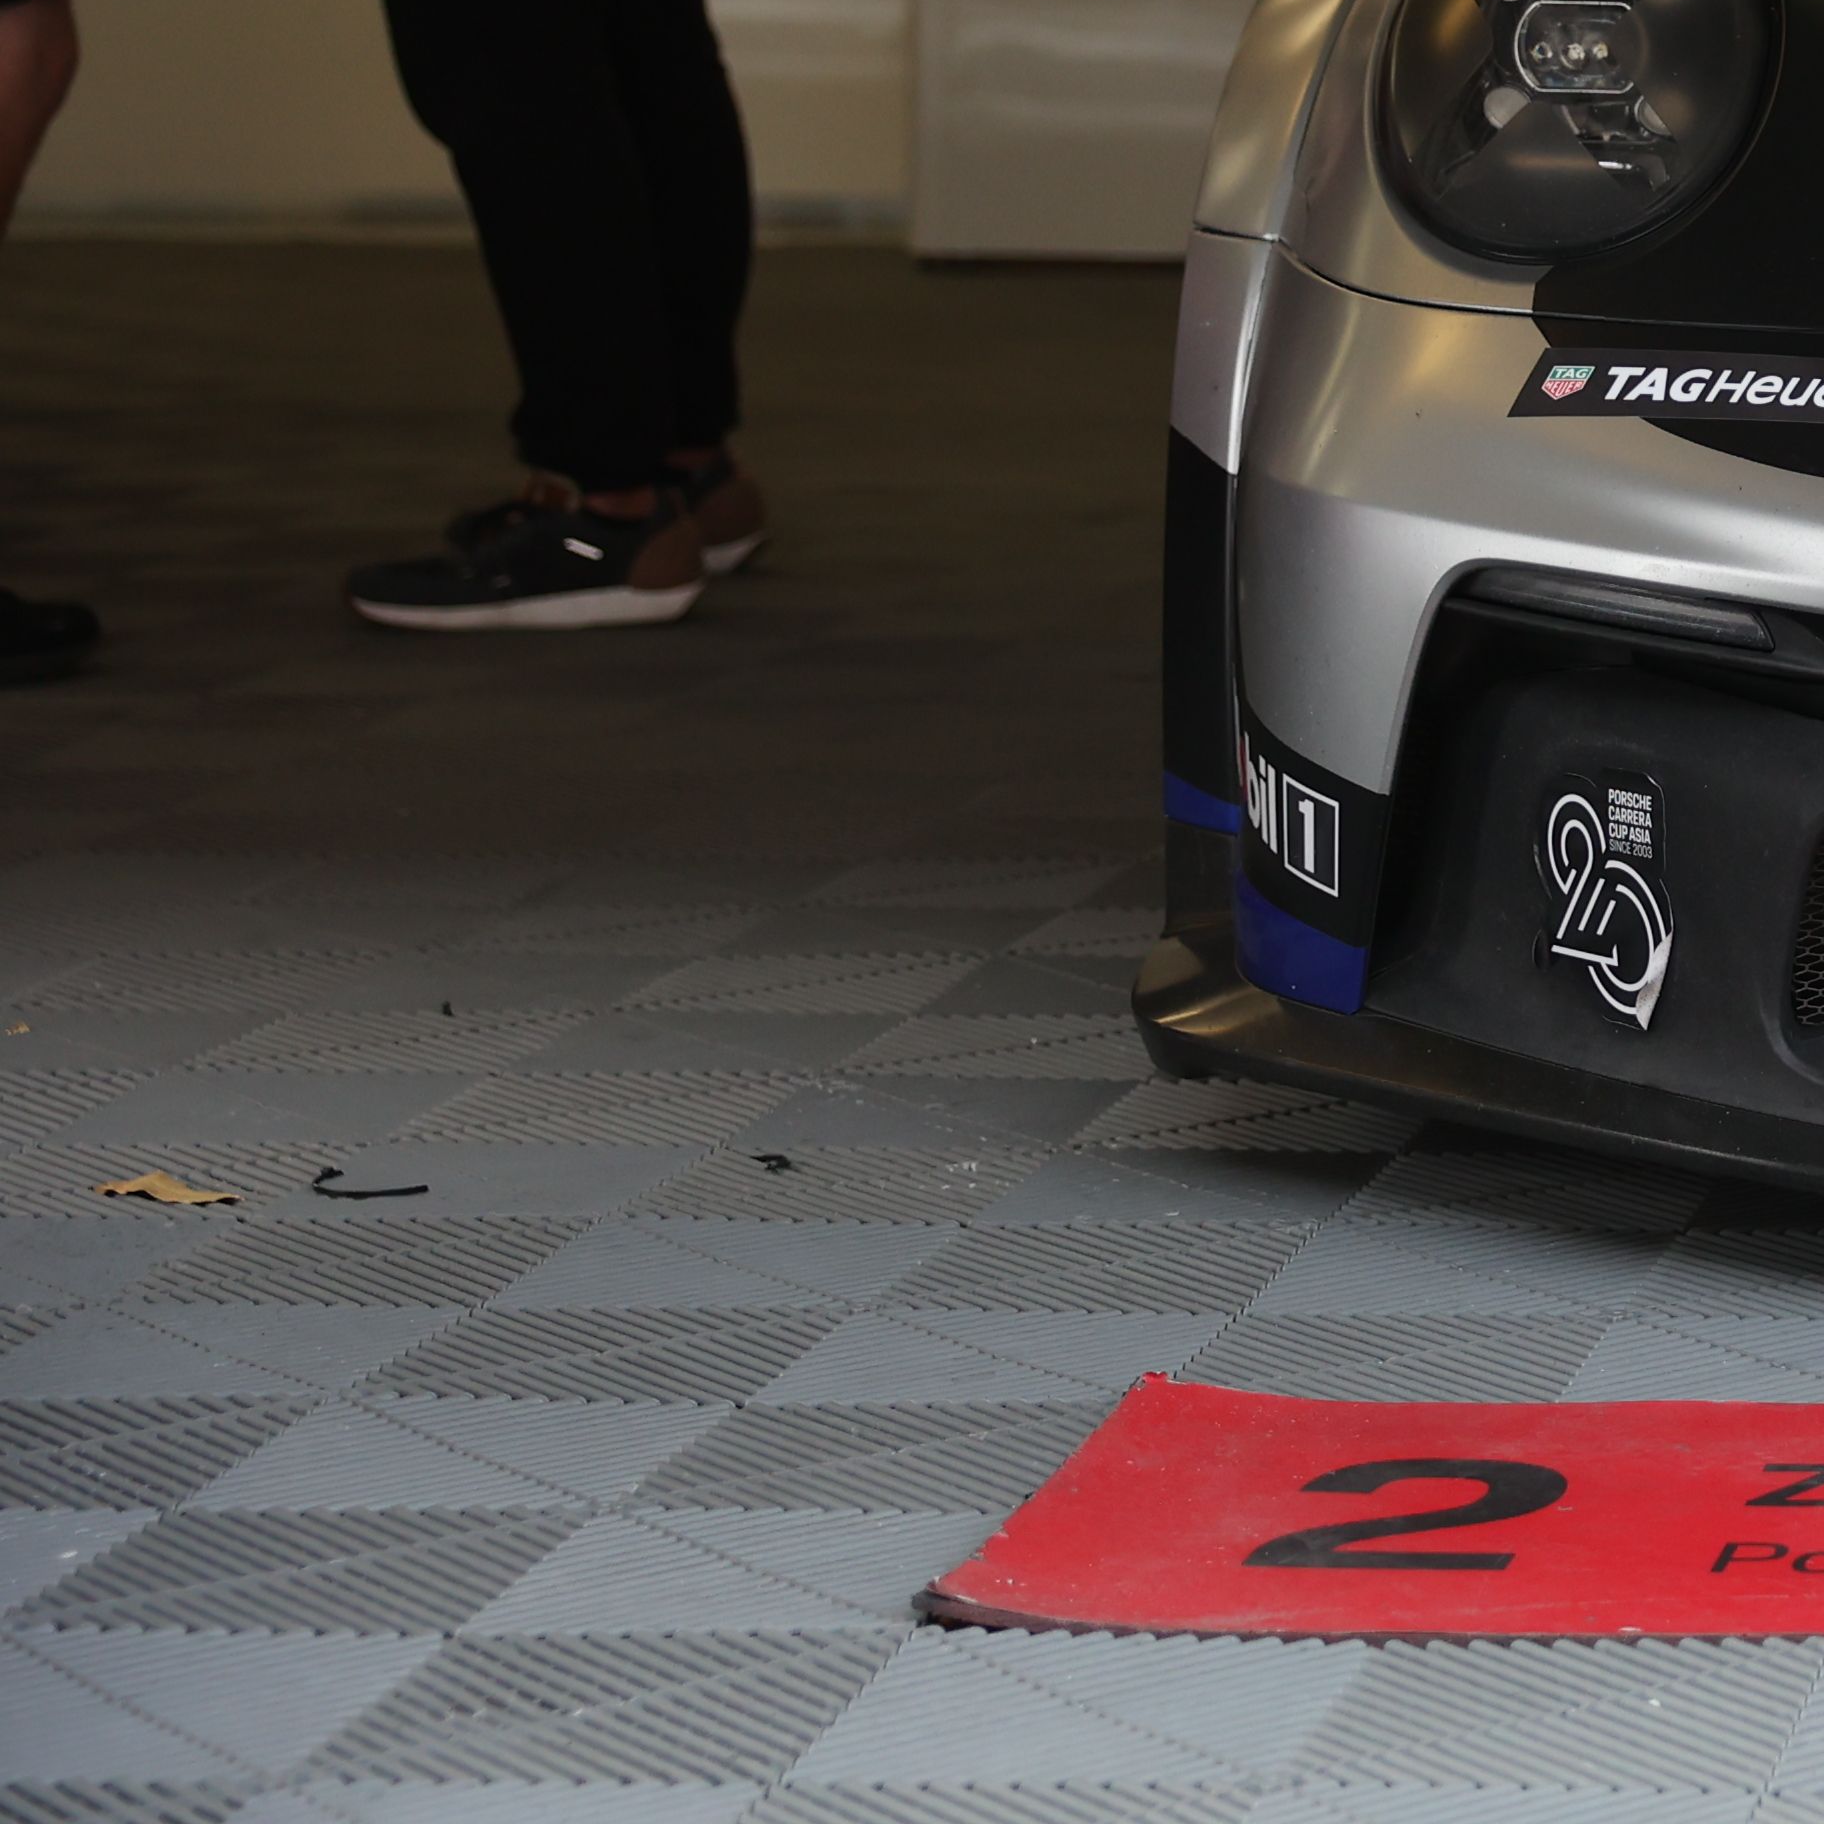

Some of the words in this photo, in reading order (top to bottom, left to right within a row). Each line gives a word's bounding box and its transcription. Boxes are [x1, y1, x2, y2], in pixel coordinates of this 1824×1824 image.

[1608, 788, 1652, 812] PORSCHE
[1608, 805, 1653, 829] CARRERA
[1298, 798, 1315, 874] 1
[1608, 822, 1629, 840] CUP
[1629, 826, 1652, 845] ASIA
[1609, 838, 1631, 855] SINCE
[1632, 843, 1653, 859] 2003
[1240, 1457, 1569, 1572] 2
